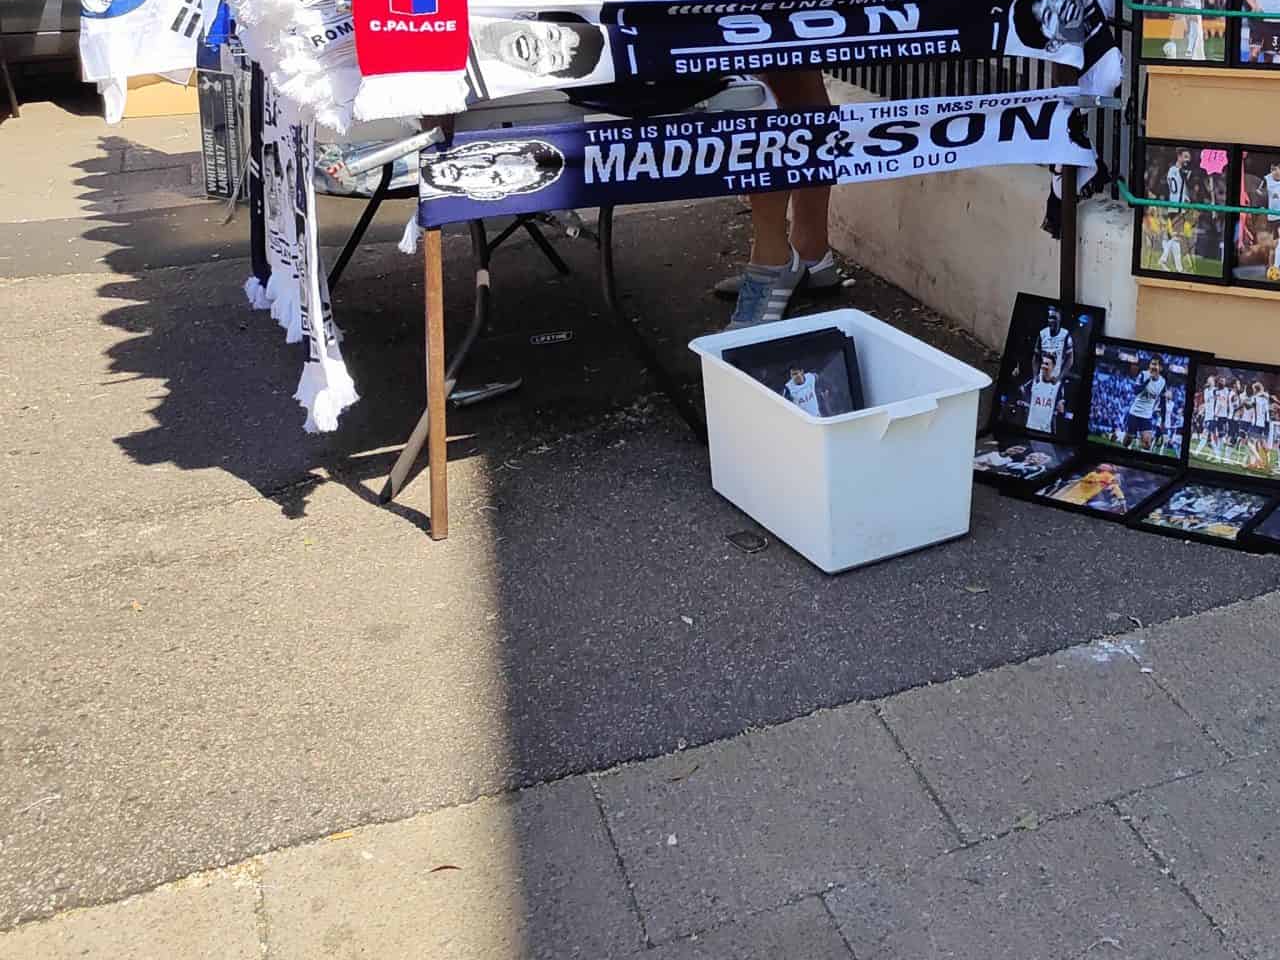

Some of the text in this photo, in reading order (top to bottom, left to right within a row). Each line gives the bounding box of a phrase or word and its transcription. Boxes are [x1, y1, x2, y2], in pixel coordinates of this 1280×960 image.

[310, 19, 355, 48] ROM
[369, 19, 458, 33] C.PALACE
[717, 3, 921, 44] SON
[675, 49, 803, 74] SUPERSPUR
[826, 43, 892, 63] SOUTH
[897, 39, 962, 58] KOREA
[587, 128, 633, 144] THIS
[640, 126, 659, 141] IS
[665, 123, 705, 139] NOT
[711, 117, 759, 135] JUST
[766, 106, 864, 129] FOOTBALL,
[868, 105, 910, 120] THIS
[912, 103, 930, 118] IS
[936, 99, 975, 115] M&S
[584, 128, 811, 185] MADDERS
[863, 100, 1060, 158] SON
[723, 150, 958, 191] THE DYNAMIC DUO
